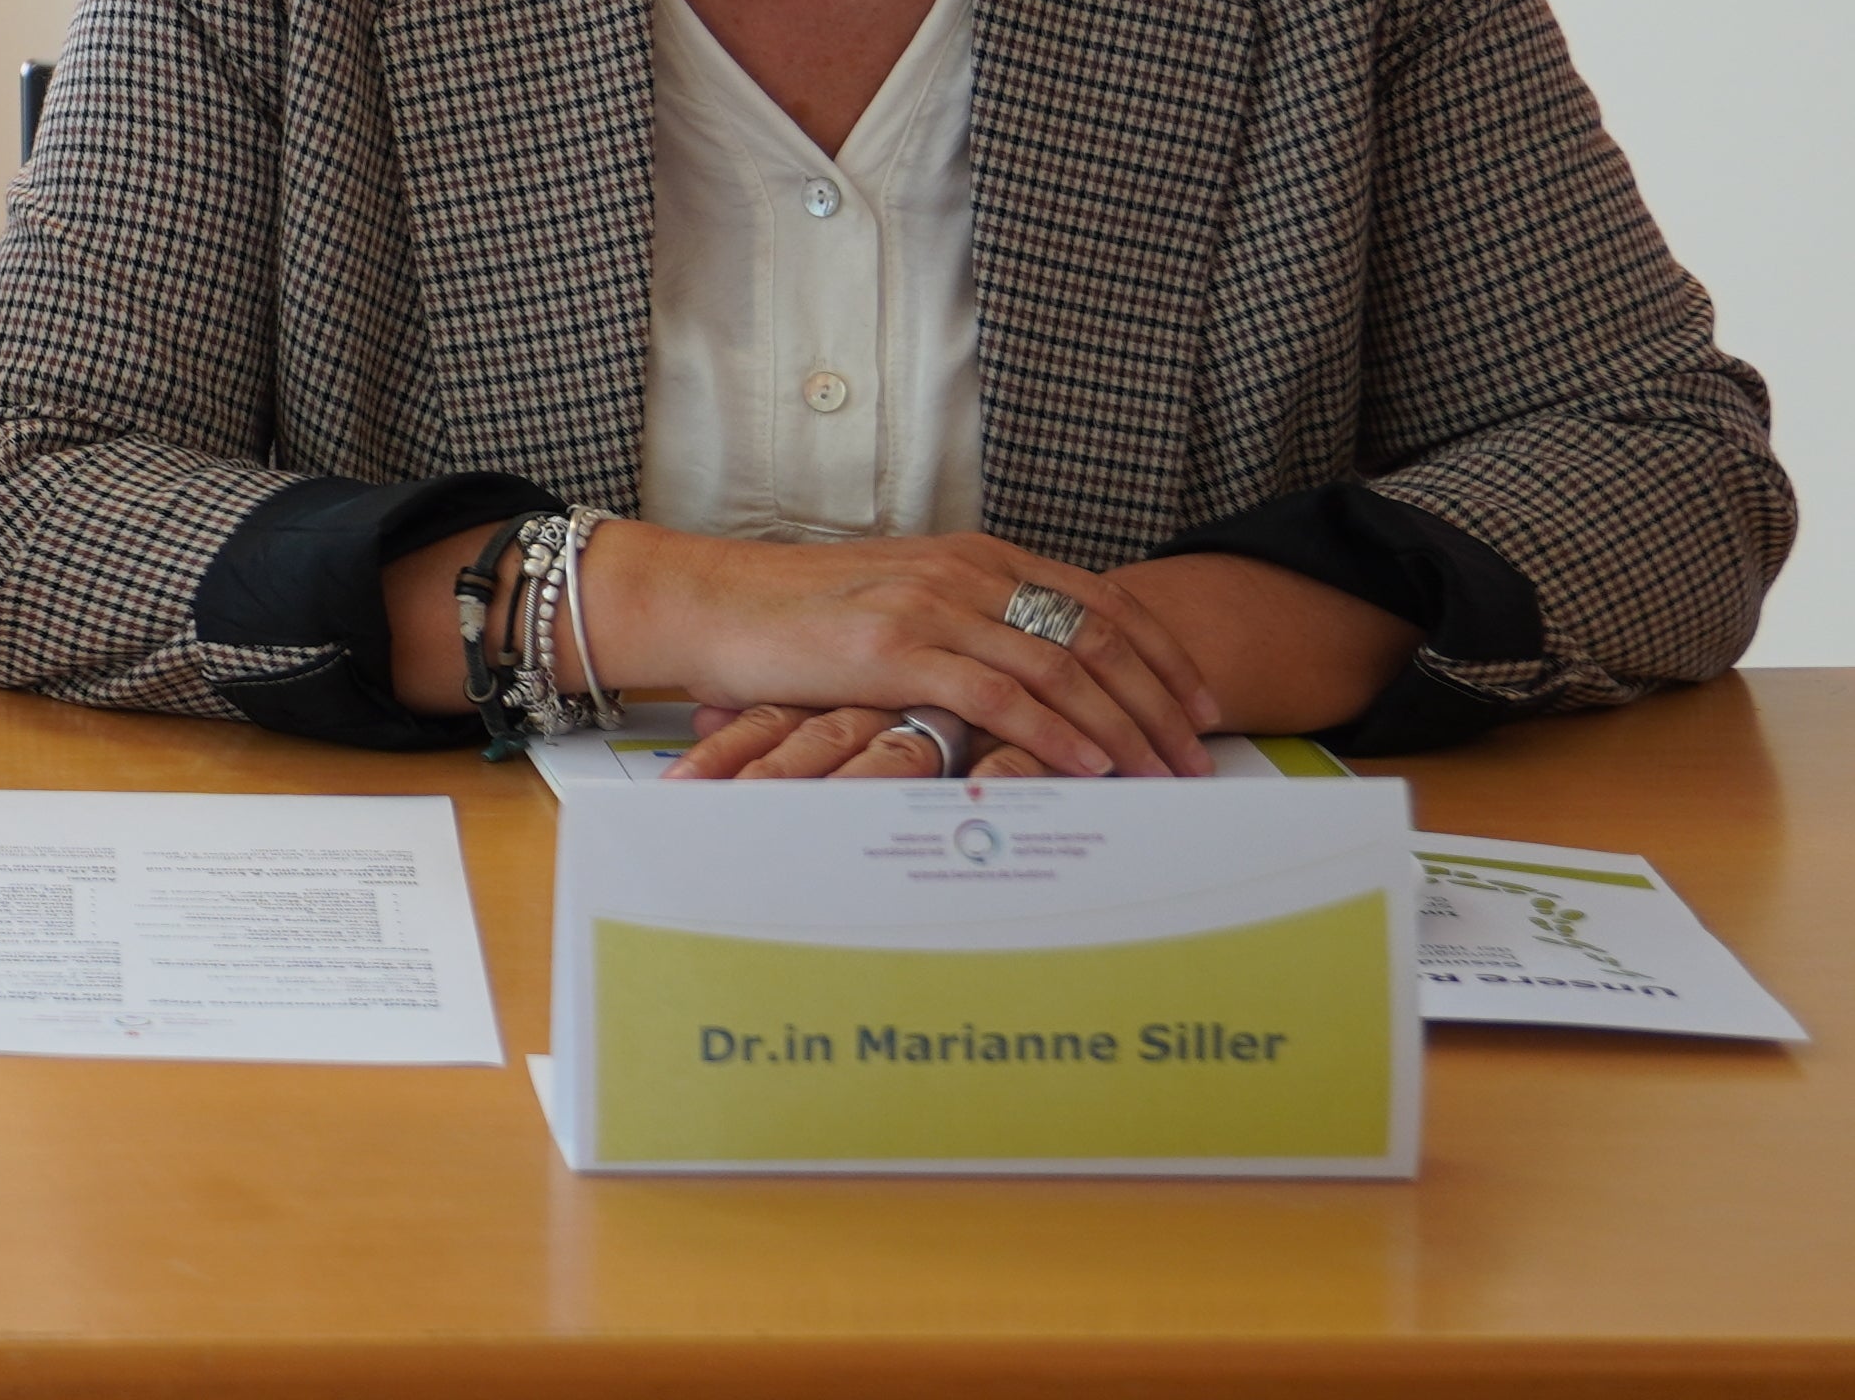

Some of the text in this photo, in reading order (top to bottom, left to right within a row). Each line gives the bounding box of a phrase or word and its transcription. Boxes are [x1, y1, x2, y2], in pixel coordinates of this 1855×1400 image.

[1475, 973, 1679, 998] Unsere
[700, 1021, 1289, 1064] Dr.in Marianne Siller
